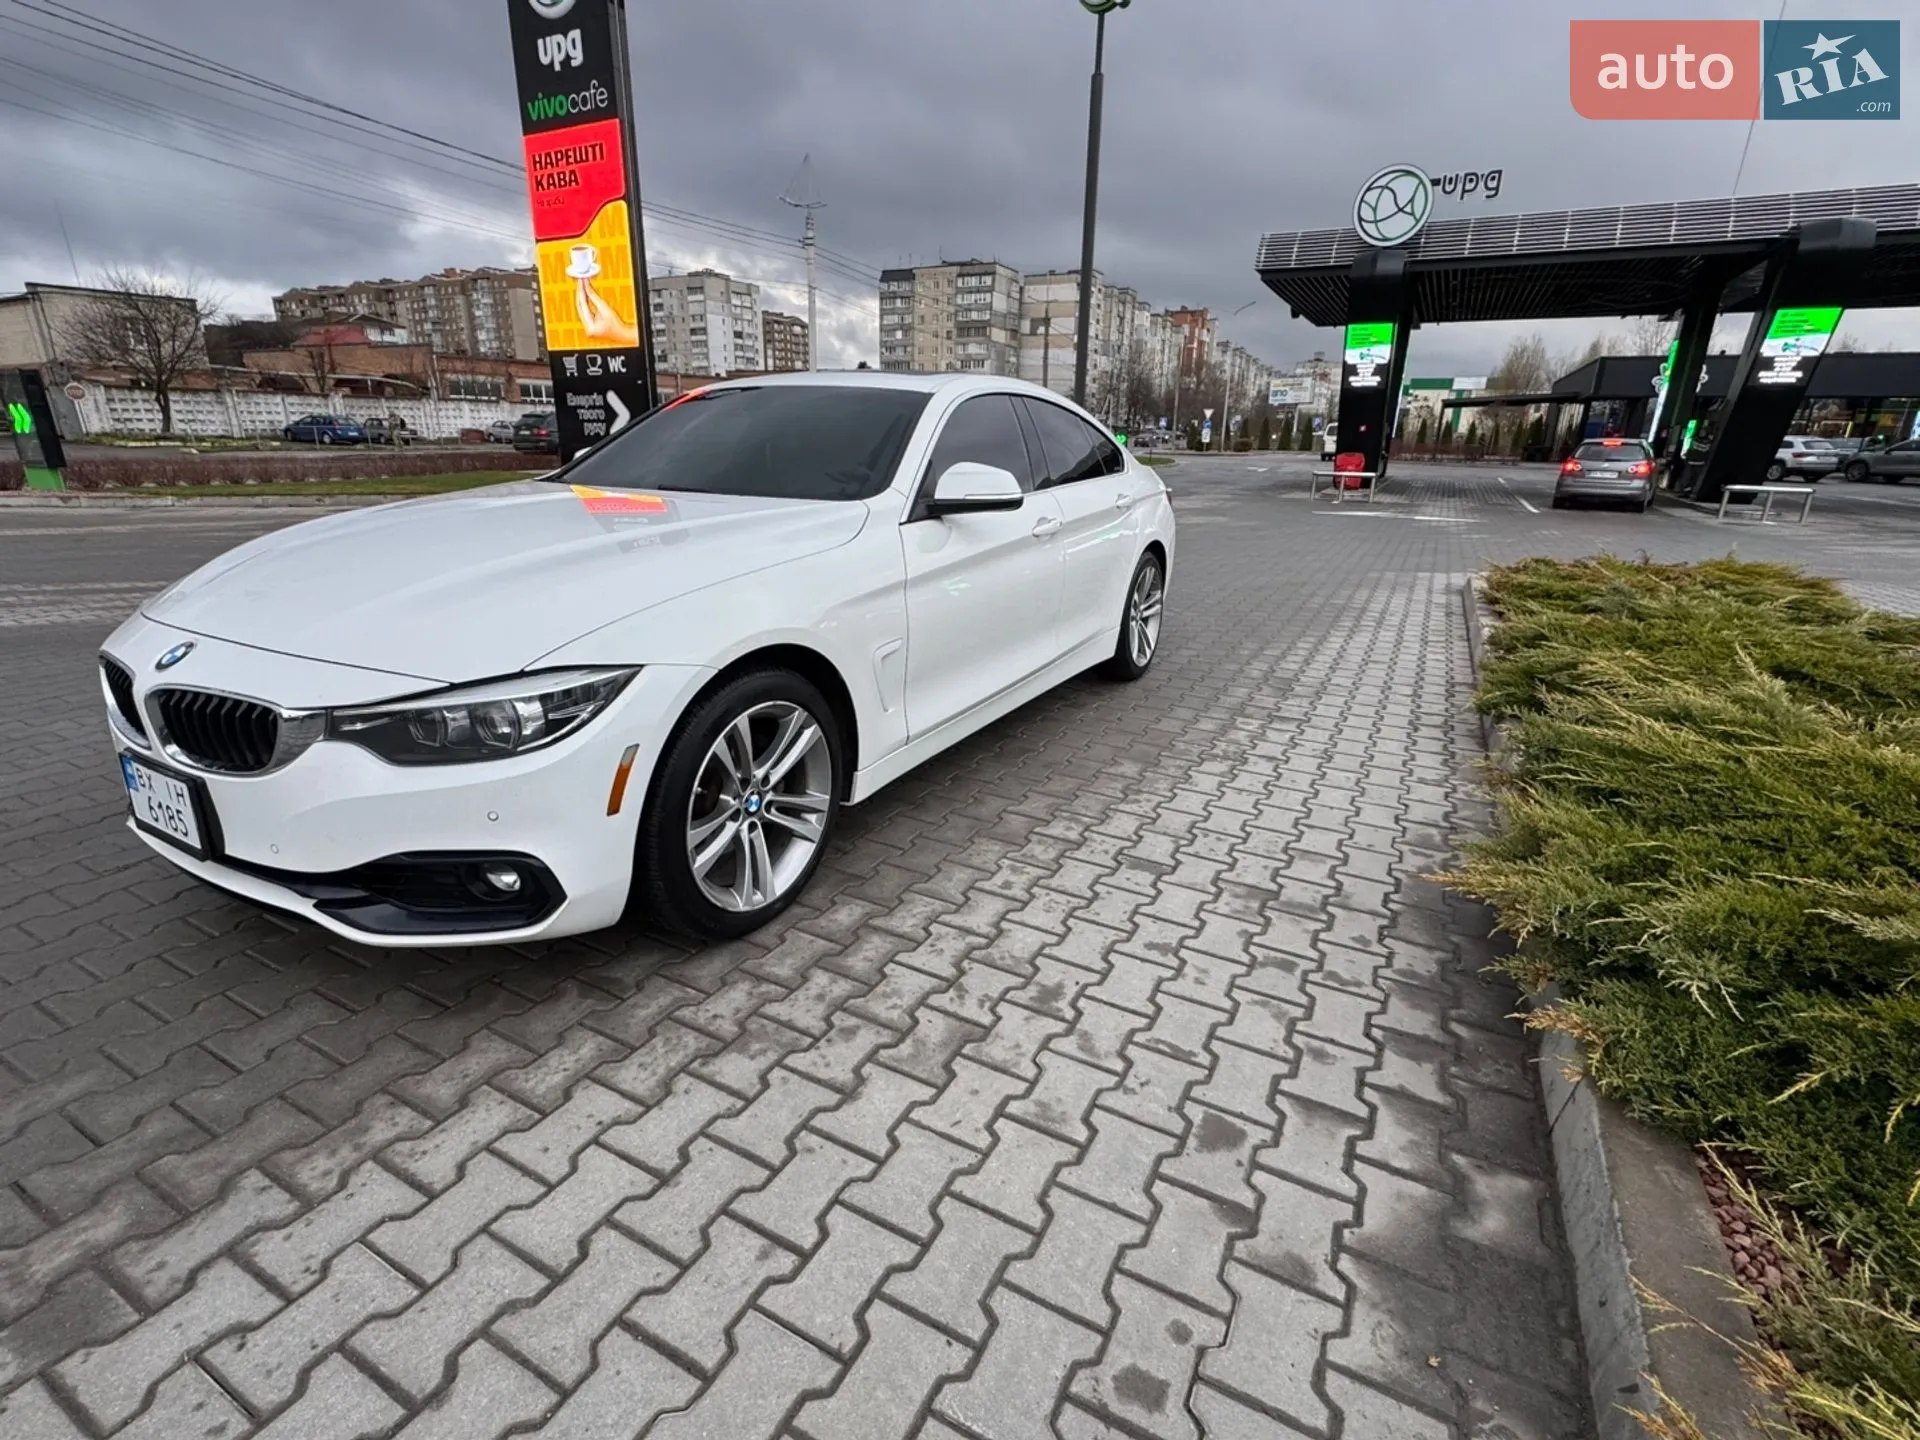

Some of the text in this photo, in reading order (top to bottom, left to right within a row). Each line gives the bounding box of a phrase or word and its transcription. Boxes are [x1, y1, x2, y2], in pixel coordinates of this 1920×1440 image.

[537, 28, 584, 71] upg
[527, 80, 608, 120] vivocafe
[531, 142, 605, 171] НАРЕШТІ
[535, 169, 580, 192] КАВА
[1441, 169, 1503, 200] upg
[607, 355, 627, 373] WC
[148, 796, 188, 837] 6185
